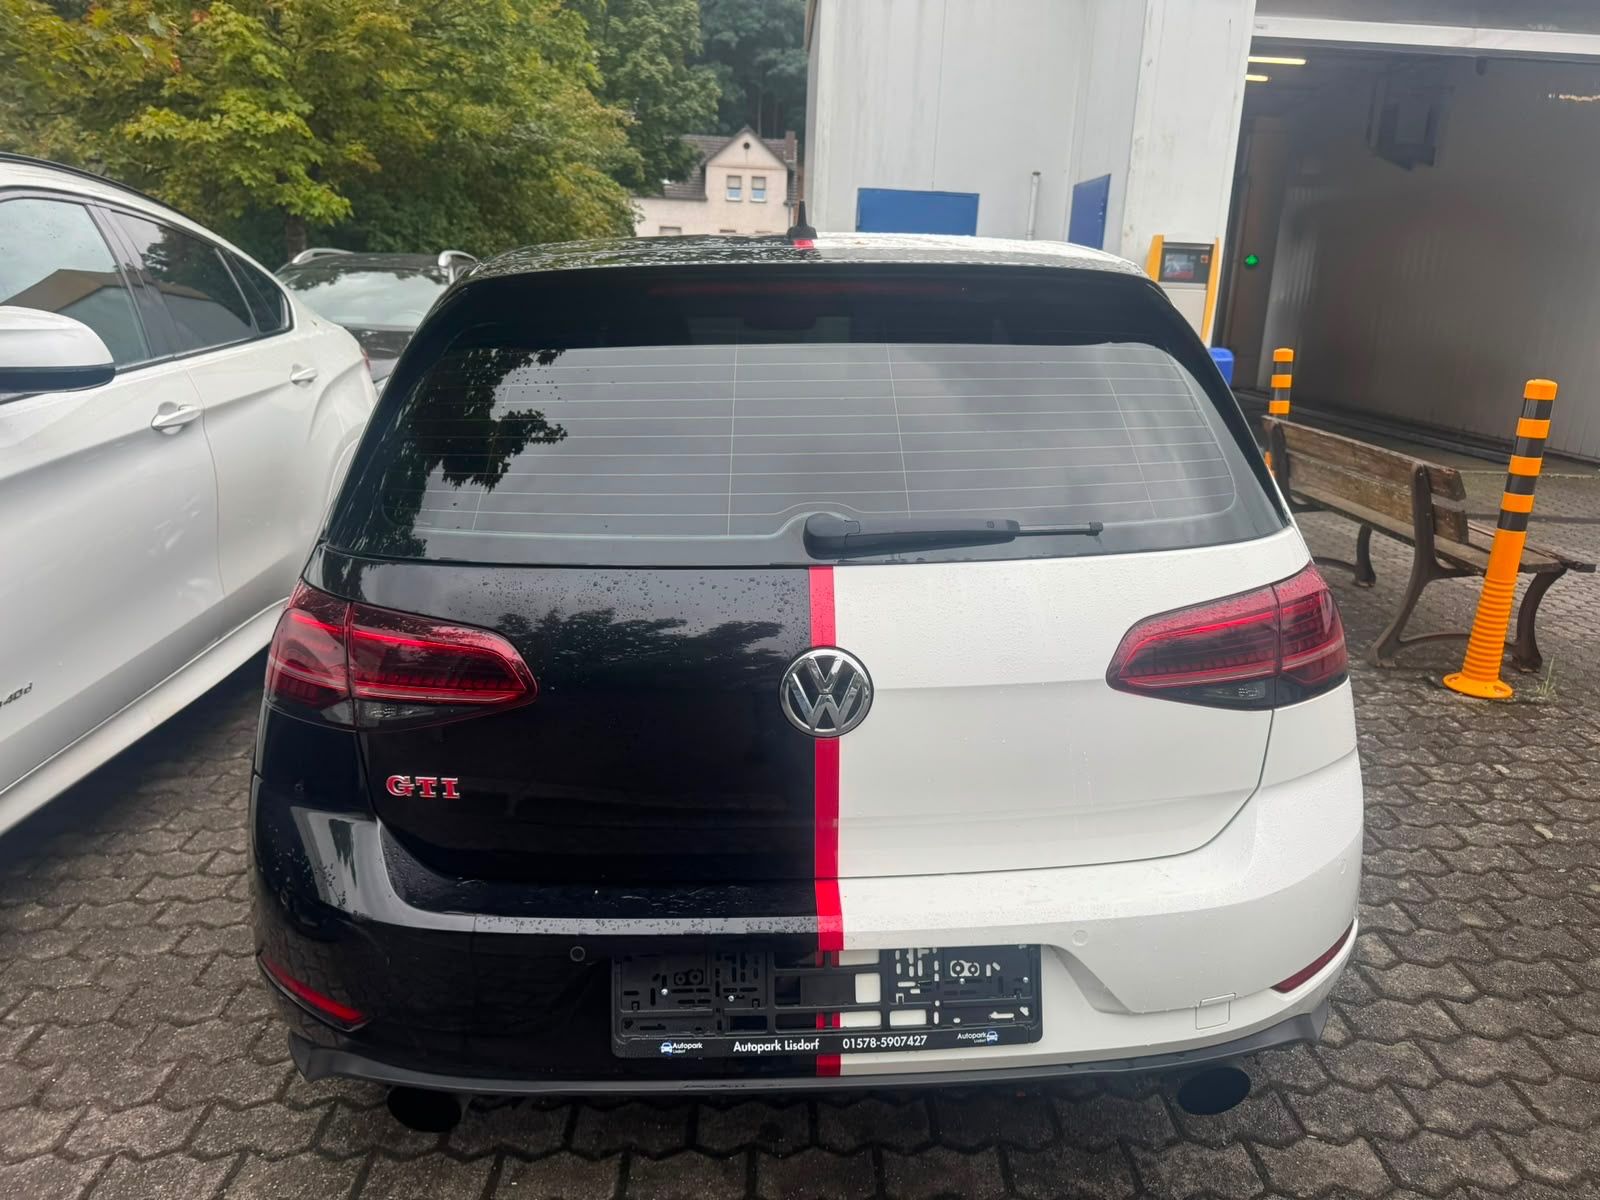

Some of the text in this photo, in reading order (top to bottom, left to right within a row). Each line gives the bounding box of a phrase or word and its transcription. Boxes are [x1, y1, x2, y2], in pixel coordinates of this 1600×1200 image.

[386, 775, 461, 799] GTI
[842, 1035, 928, 1049] 01578-5907427
[957, 1031, 987, 1040] Autopark
[672, 1042, 703, 1050] Autopark
[733, 1038, 820, 1054] Autopark Lisdorf
